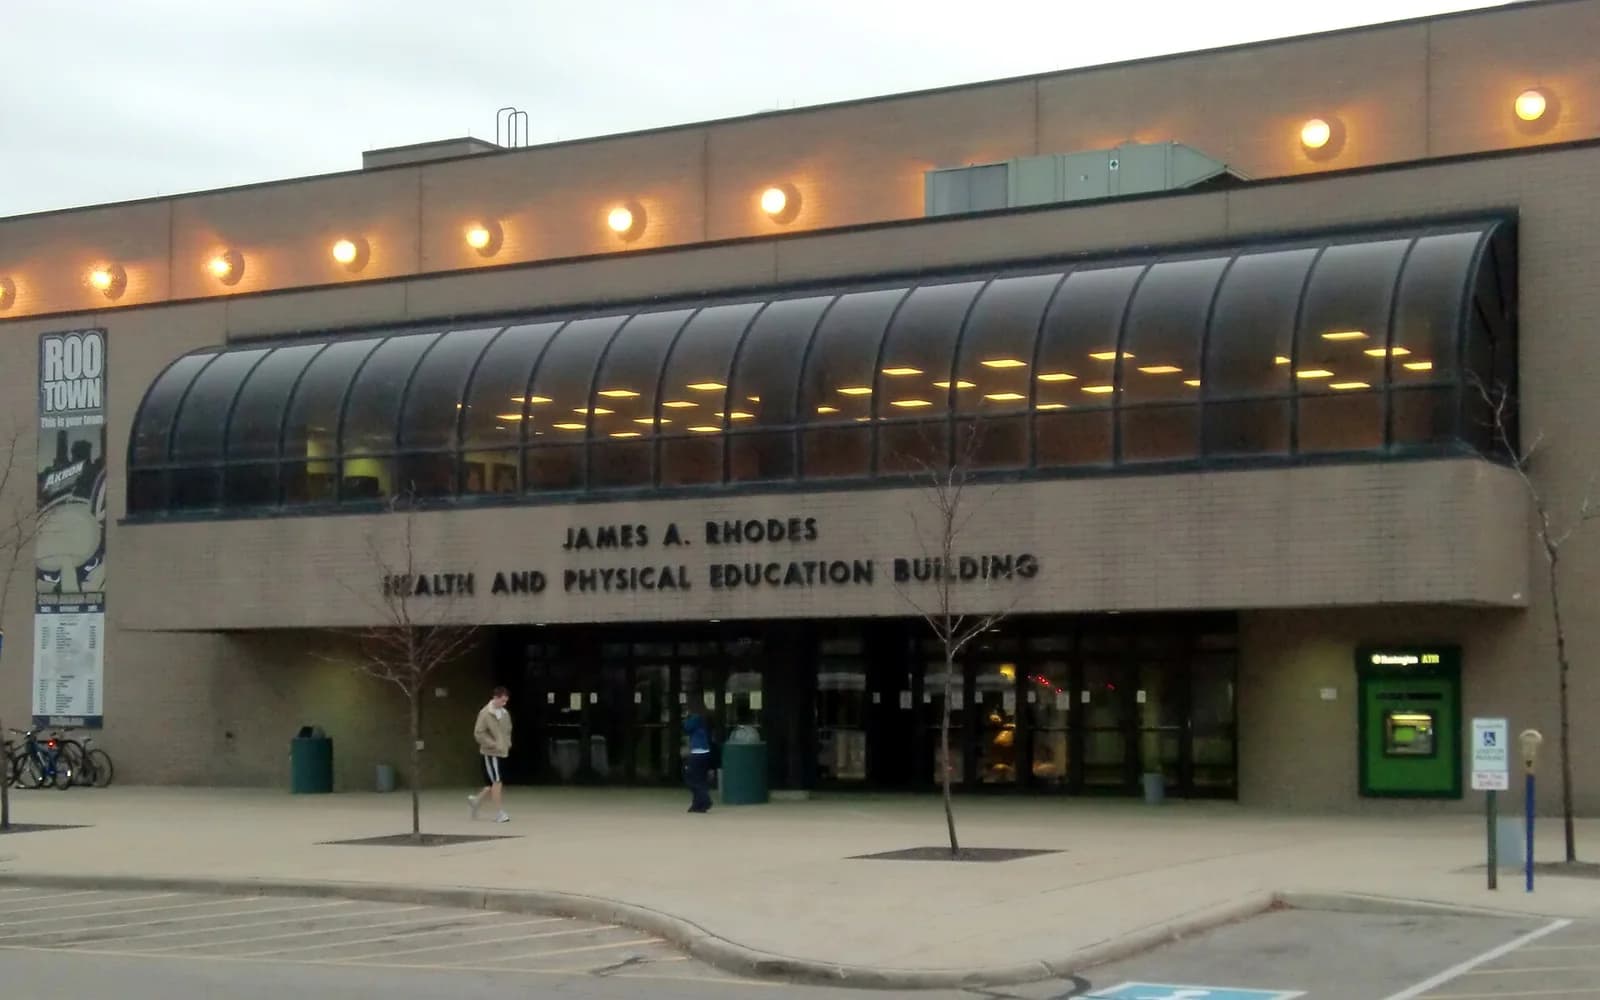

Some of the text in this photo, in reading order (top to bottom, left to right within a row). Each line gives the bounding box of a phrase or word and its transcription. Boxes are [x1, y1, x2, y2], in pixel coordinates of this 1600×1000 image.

[44, 333, 101, 381] ROO
[44, 378, 101, 411] TOWN
[563, 518, 818, 550] JAMES A. RHODES
[383, 554, 1039, 597] HEALTH AND PHYSICAL EDUCATION BUILDING
